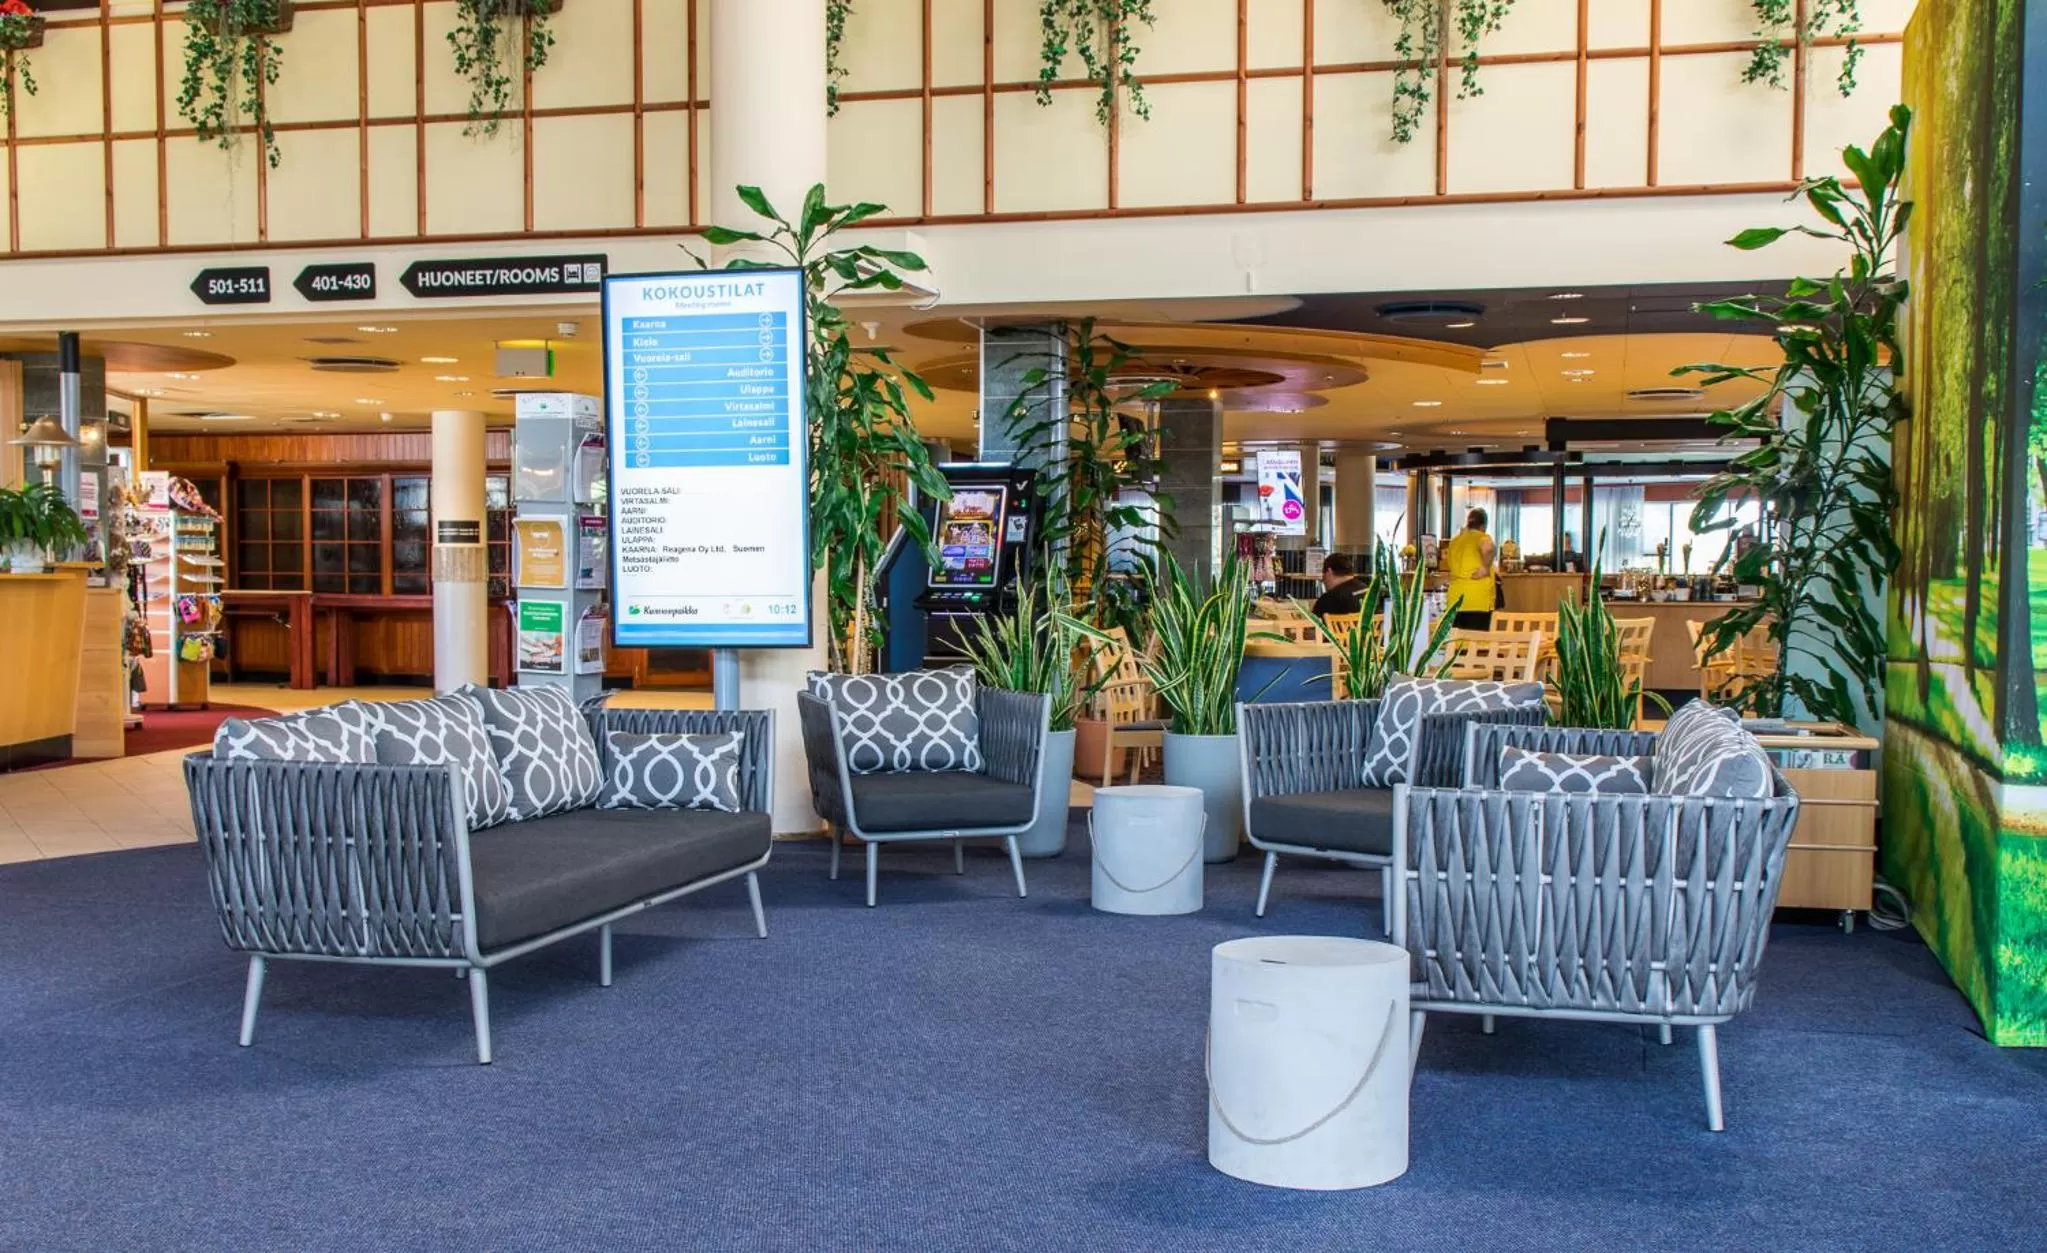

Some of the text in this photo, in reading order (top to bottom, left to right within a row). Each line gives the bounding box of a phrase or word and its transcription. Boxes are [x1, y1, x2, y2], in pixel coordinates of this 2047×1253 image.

[417, 267, 560, 287] HUONEET/ROOMS
[208, 277, 266, 294] 501-511
[311, 274, 371, 291] 401-430
[643, 283, 765, 300] KOKOUSTILAT
[633, 320, 667, 329] Kaarna
[727, 367, 774, 377] Auditorio
[724, 401, 775, 412] Virtasalmi
[750, 434, 776, 444] Aarni
[748, 452, 776, 462] Luoto
[768, 604, 797, 614] 10:12
